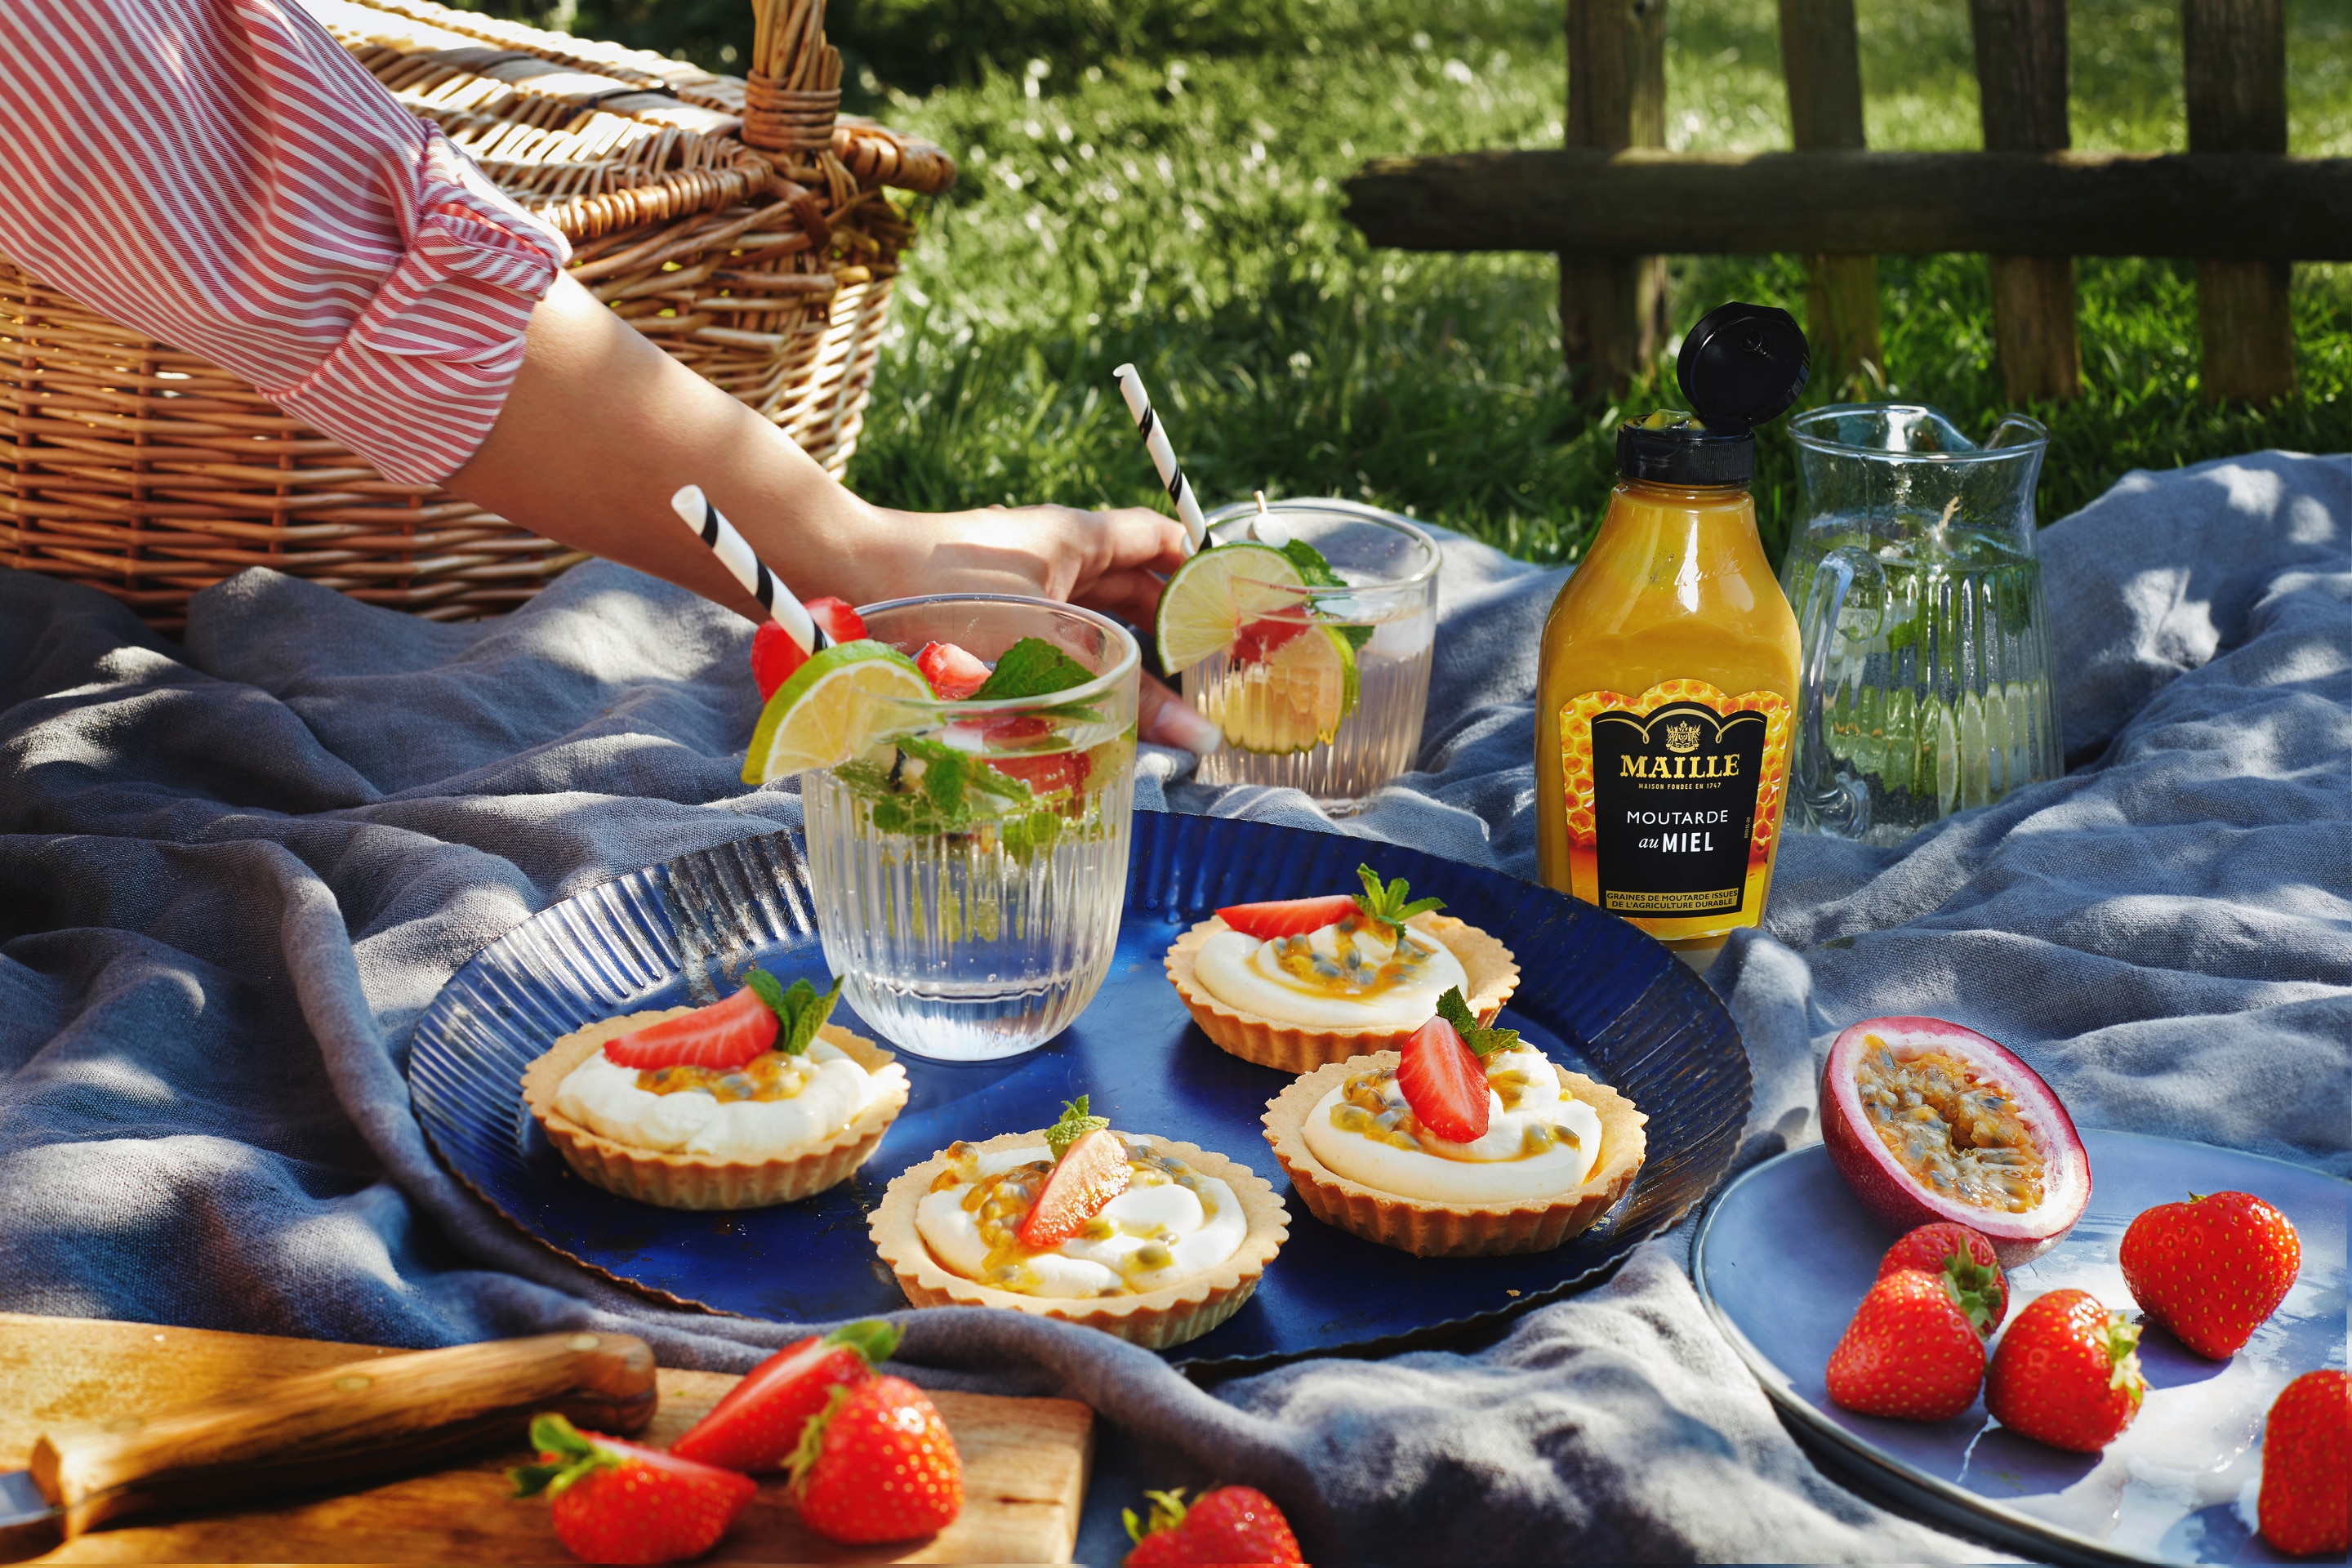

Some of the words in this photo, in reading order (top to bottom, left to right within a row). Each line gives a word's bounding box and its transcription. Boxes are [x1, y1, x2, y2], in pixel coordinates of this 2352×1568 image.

[1619, 753, 1740, 779] MAILLE
[1627, 809, 1728, 826] MOUTARDE
[1638, 837, 1659, 849] au
[1662, 831, 1714, 853] MIEL
[1606, 893, 1646, 902] GRAINES
[1661, 893, 1709, 902] MOUTARDE
[1711, 889, 1738, 899] ISSUES
[1695, 898, 1733, 908] DURABLE
